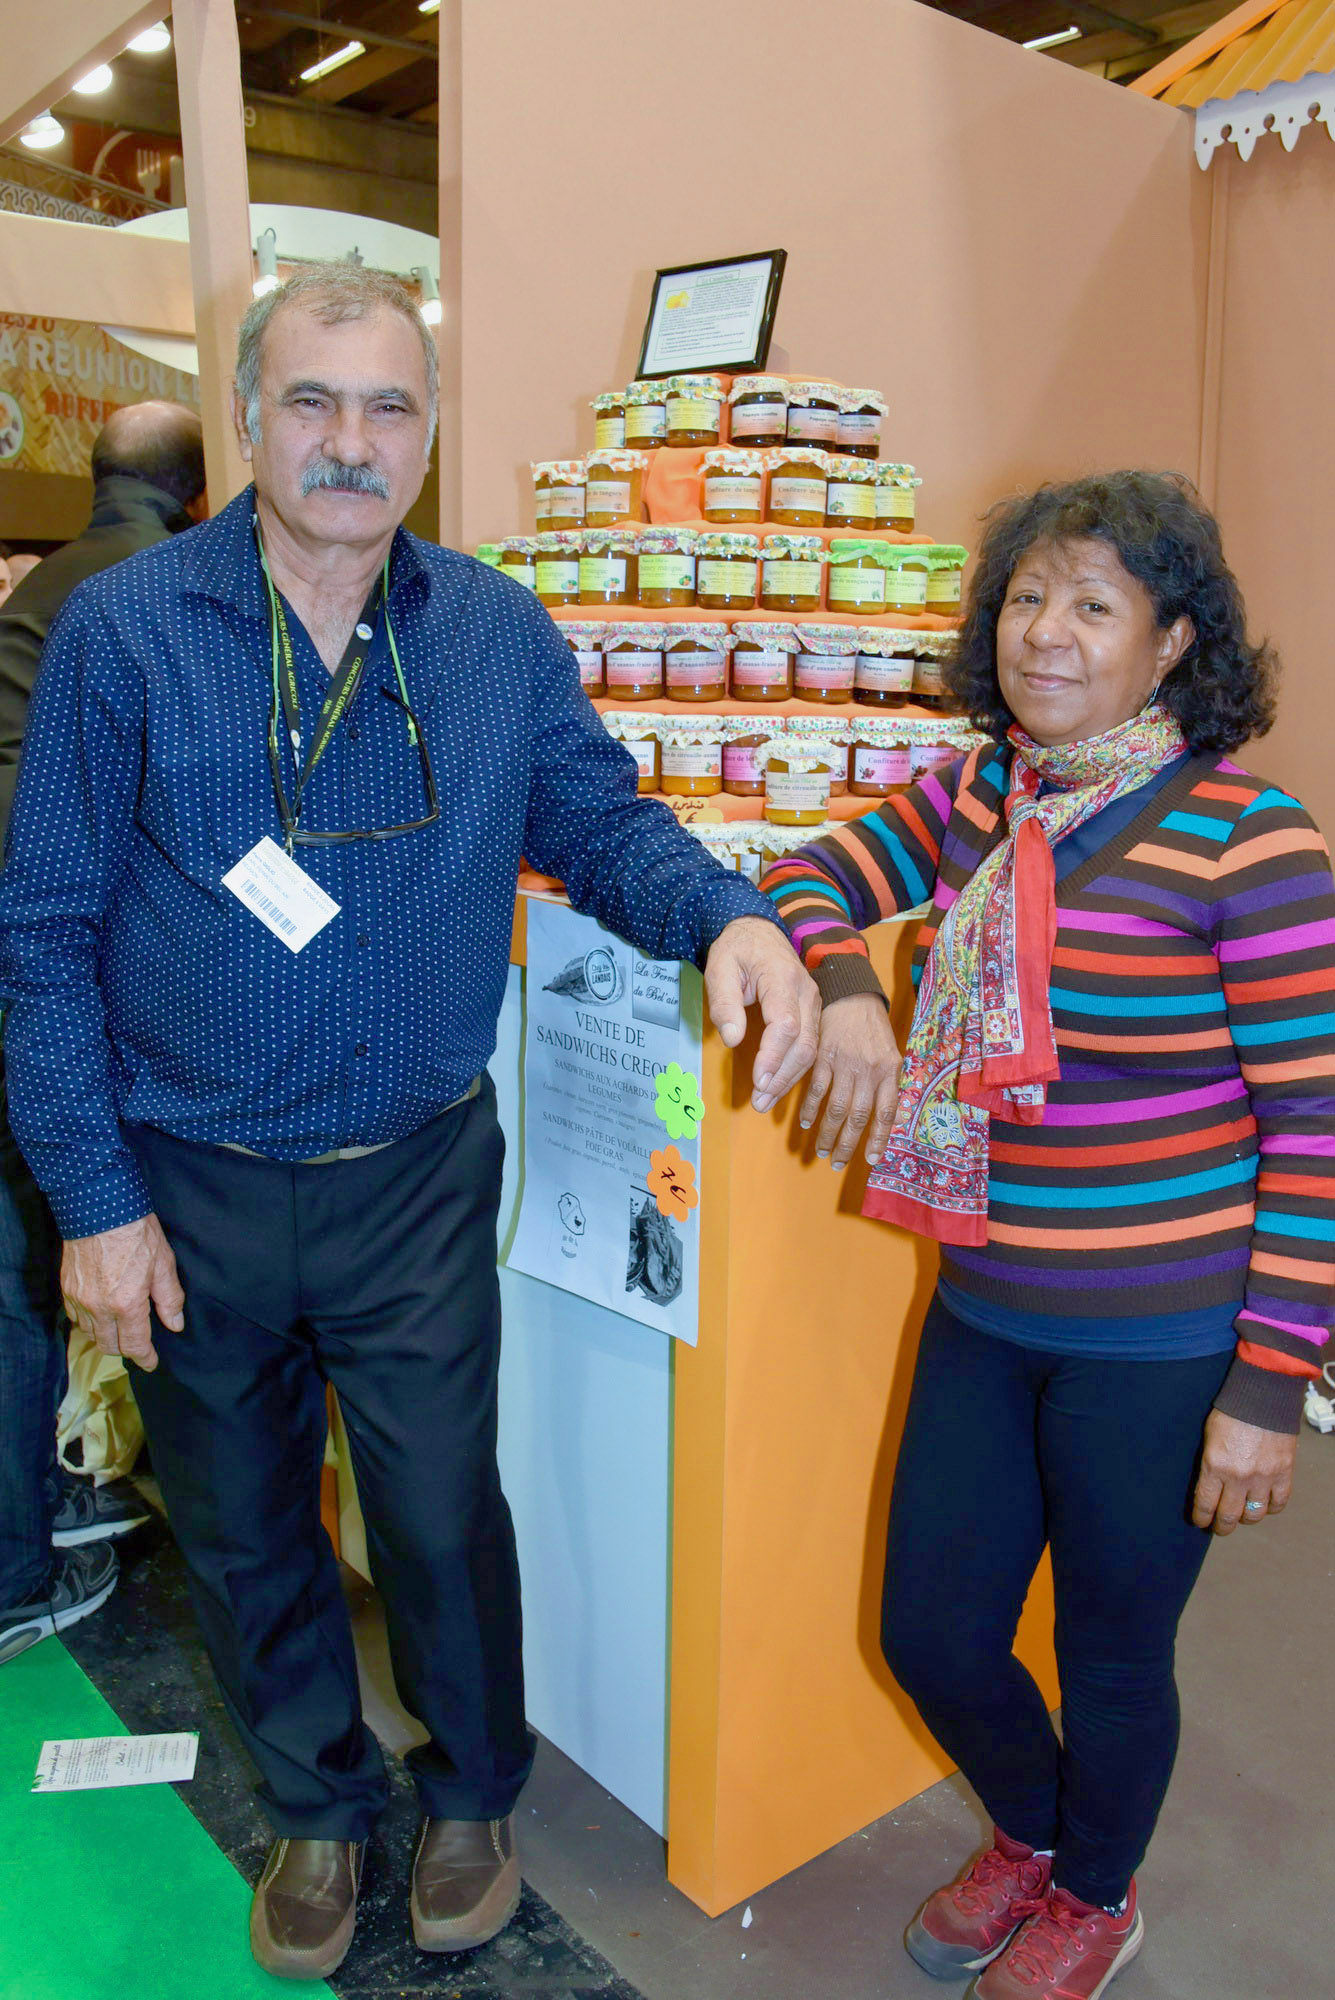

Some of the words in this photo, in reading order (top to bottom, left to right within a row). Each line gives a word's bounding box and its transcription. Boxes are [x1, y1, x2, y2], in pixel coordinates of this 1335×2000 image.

[27, 328, 165, 396] RÉUNION
[341, 656, 362, 696] CONCOURS
[536, 1025, 617, 1067] SANDWICHS
[575, 1011, 621, 1041] VENTE
[625, 1026, 646, 1048] DE
[554, 1058, 595, 1081] SANDWICHS
[596, 1074, 611, 1087] AUX
[612, 1079, 648, 1099] ACHARDS
[588, 1083, 622, 1104] LEGUMES
[542, 1111, 584, 1136] SANDWICHS
[605, 1134, 616, 1146] DE
[617, 1138, 651, 1160] VOLAILL
[585, 1140, 601, 1154] FOIE
[603, 1147, 624, 1161] GRAS
